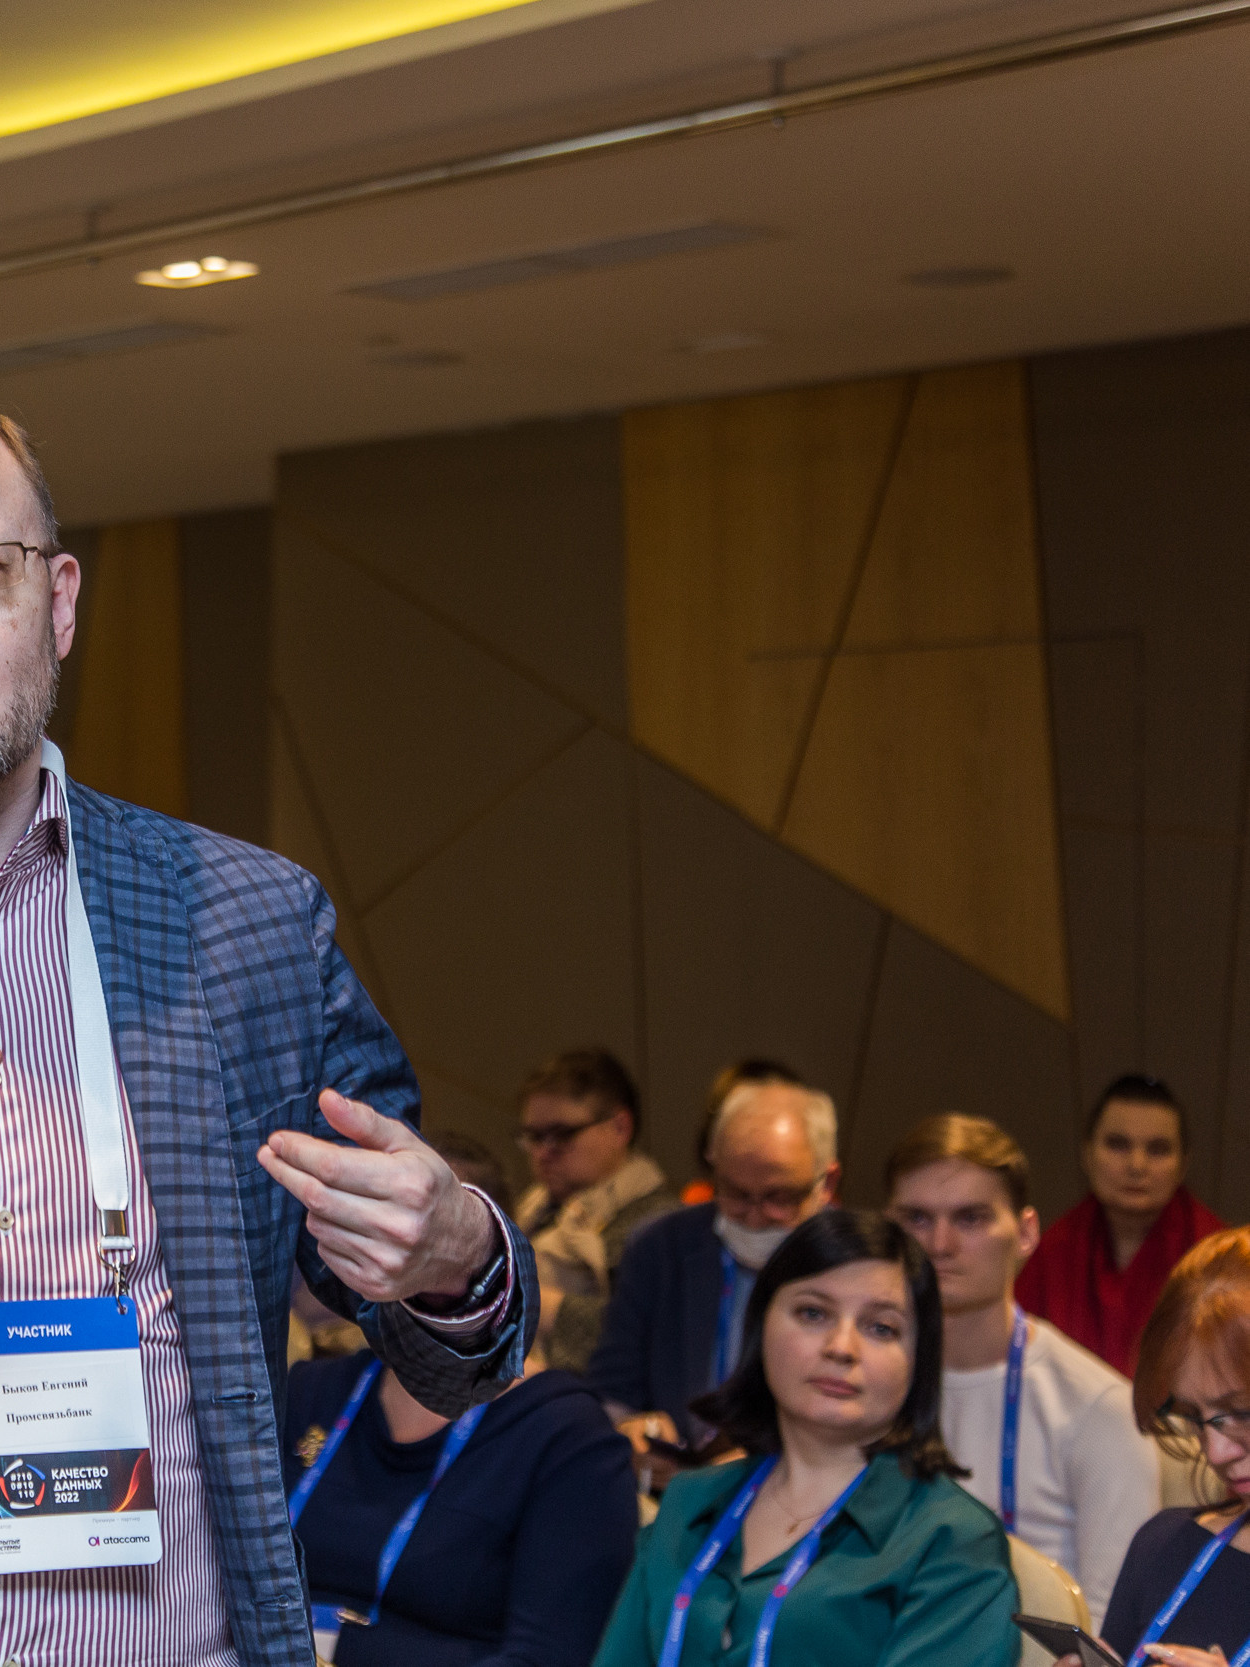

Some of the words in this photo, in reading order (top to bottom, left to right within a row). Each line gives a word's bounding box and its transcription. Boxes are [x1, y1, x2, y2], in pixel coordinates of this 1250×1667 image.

[7, 1324, 72, 1339] УЧАСТНИК
[2, 1384, 39, 1395] Быков
[42, 1378, 88, 1391] Евгений
[6, 1408, 93, 1425] Промсвязьбанк
[51, 1466, 109, 1480] КАЧЕСТВО
[53, 1478, 102, 1492] ДАННЫХ
[55, 1492, 80, 1503] 2022
[103, 1535, 150, 1545] ataccama
